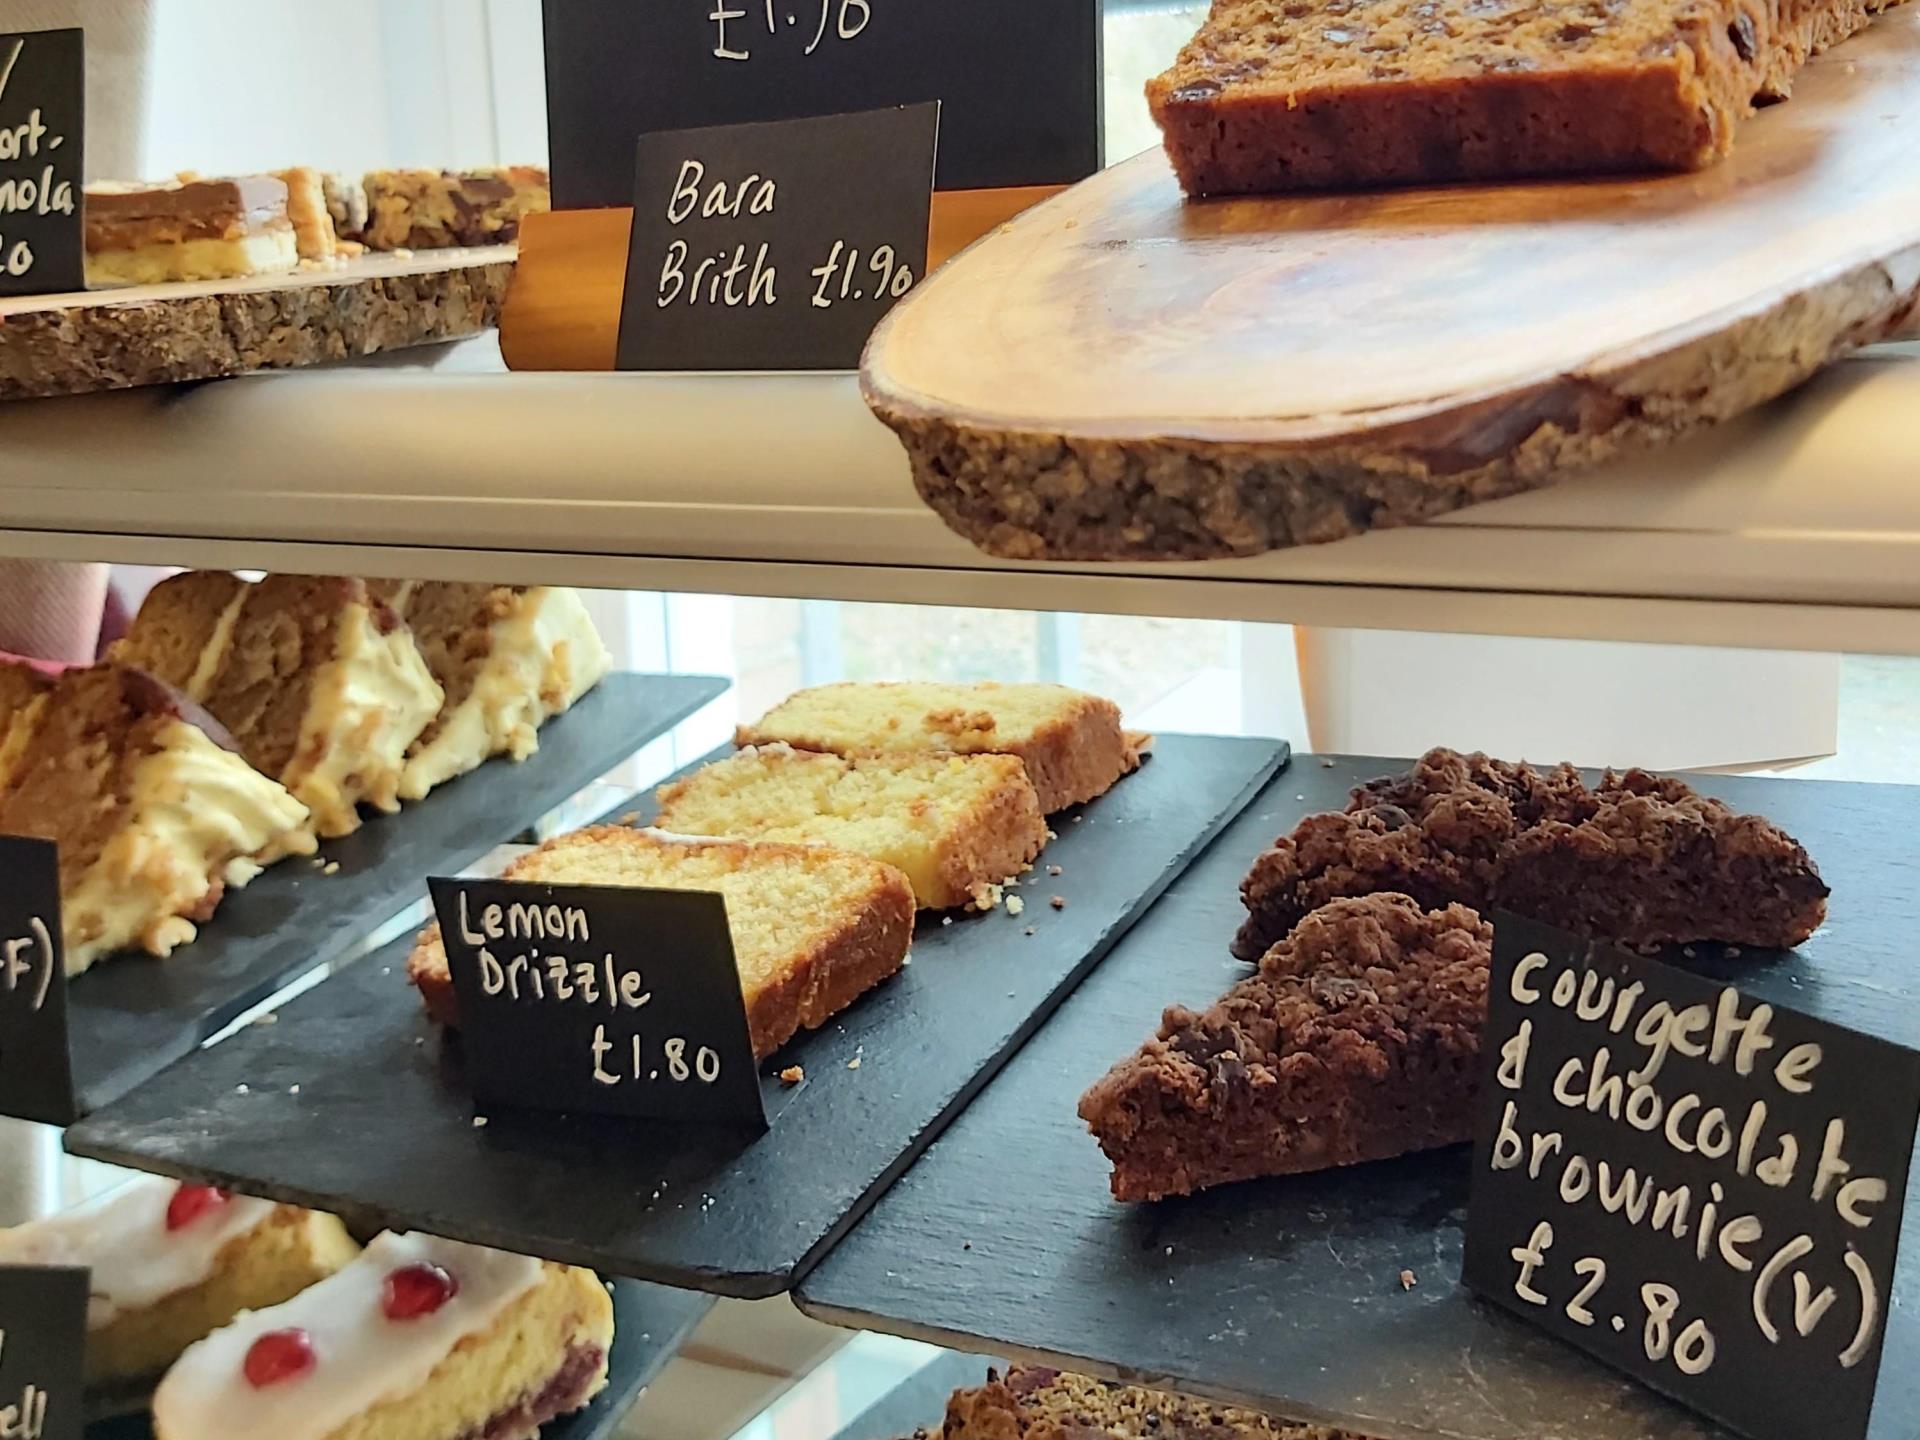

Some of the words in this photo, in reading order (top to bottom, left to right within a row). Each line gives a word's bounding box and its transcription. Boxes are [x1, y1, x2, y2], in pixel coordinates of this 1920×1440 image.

[666, 159, 776, 225] Bara
[656, 239, 777, 309] Brith
[810, 239, 914, 309] £1.90
[459, 889, 590, 946] Lemon
[478, 946, 652, 1009] Drizzle
[591, 1023, 721, 1085] £1.80
[1552, 1046, 1888, 1228] chocolate
[1510, 1220, 1717, 1376] £2.80
